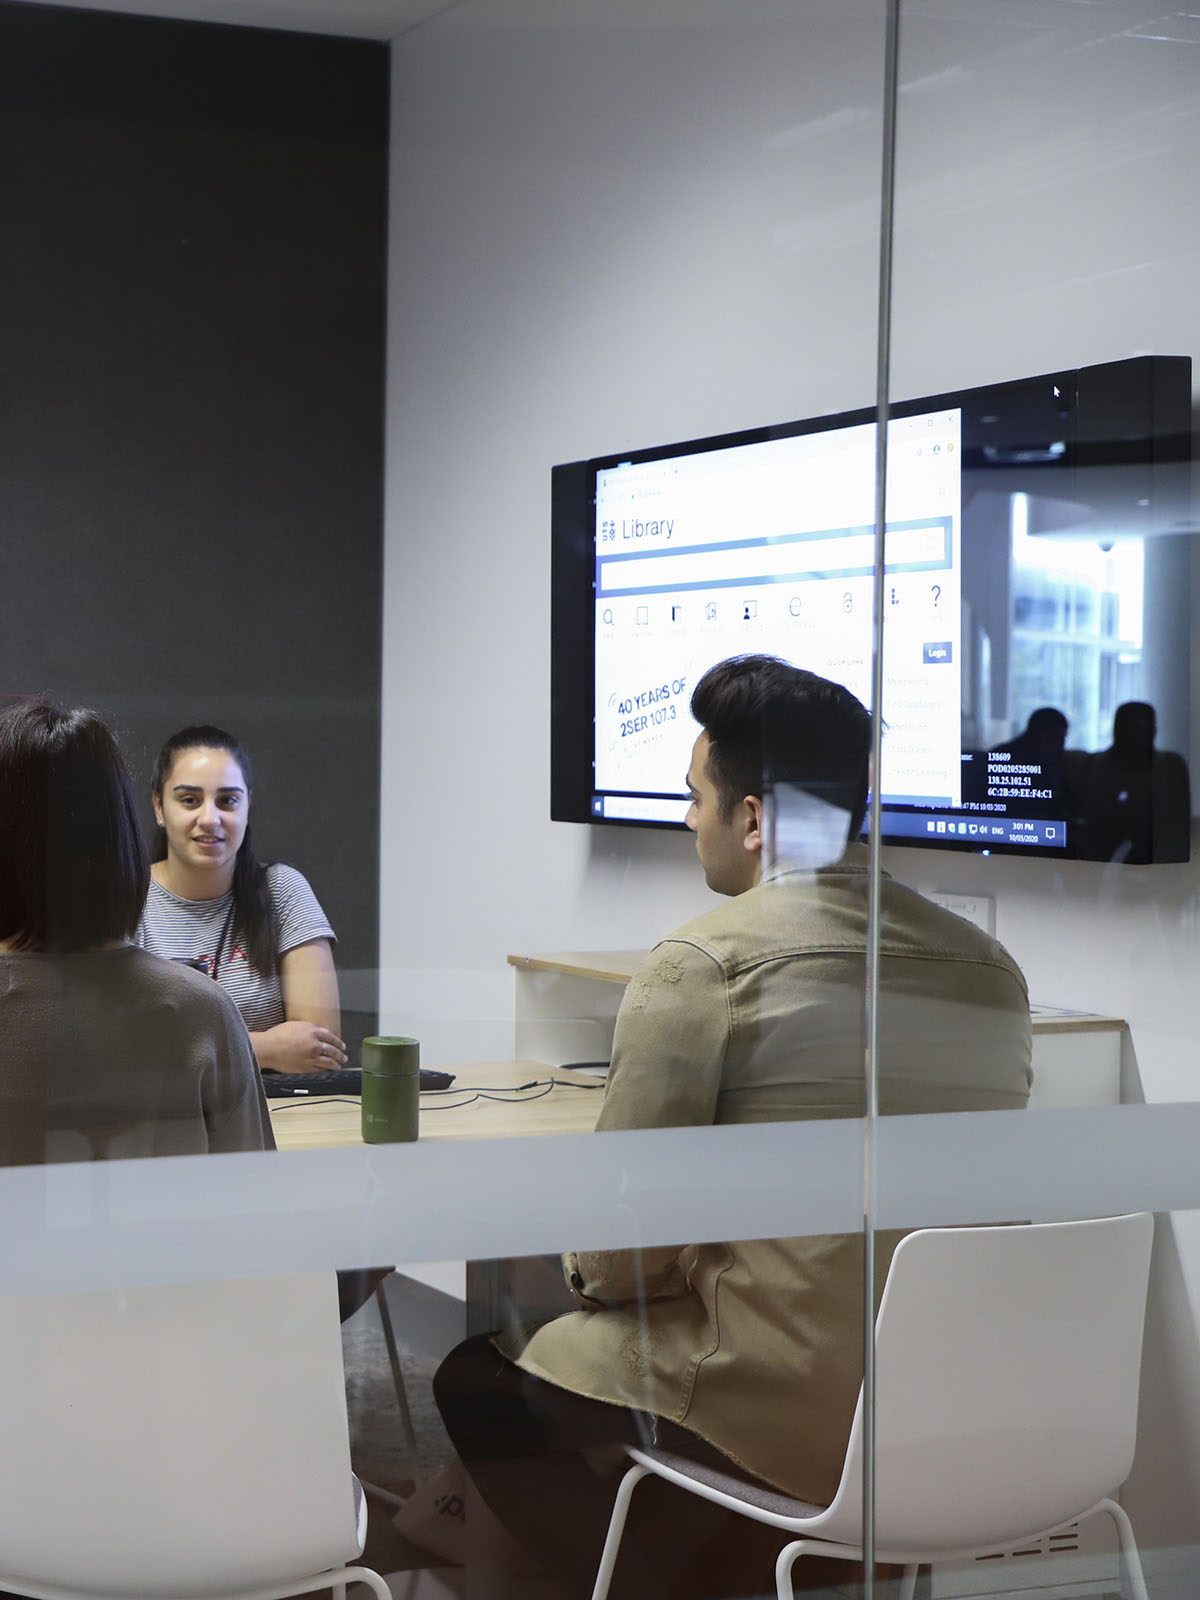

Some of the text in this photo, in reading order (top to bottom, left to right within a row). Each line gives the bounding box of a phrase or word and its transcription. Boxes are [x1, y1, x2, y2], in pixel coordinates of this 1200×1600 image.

[623, 519, 674, 540] Library
[928, 649, 947, 659] Login
[618, 677, 686, 715] 40 YEARS OF
[620, 704, 677, 738] 2SER 107.3
[991, 827, 1004, 835] ENG
[1024, 823, 1034, 831] PM
